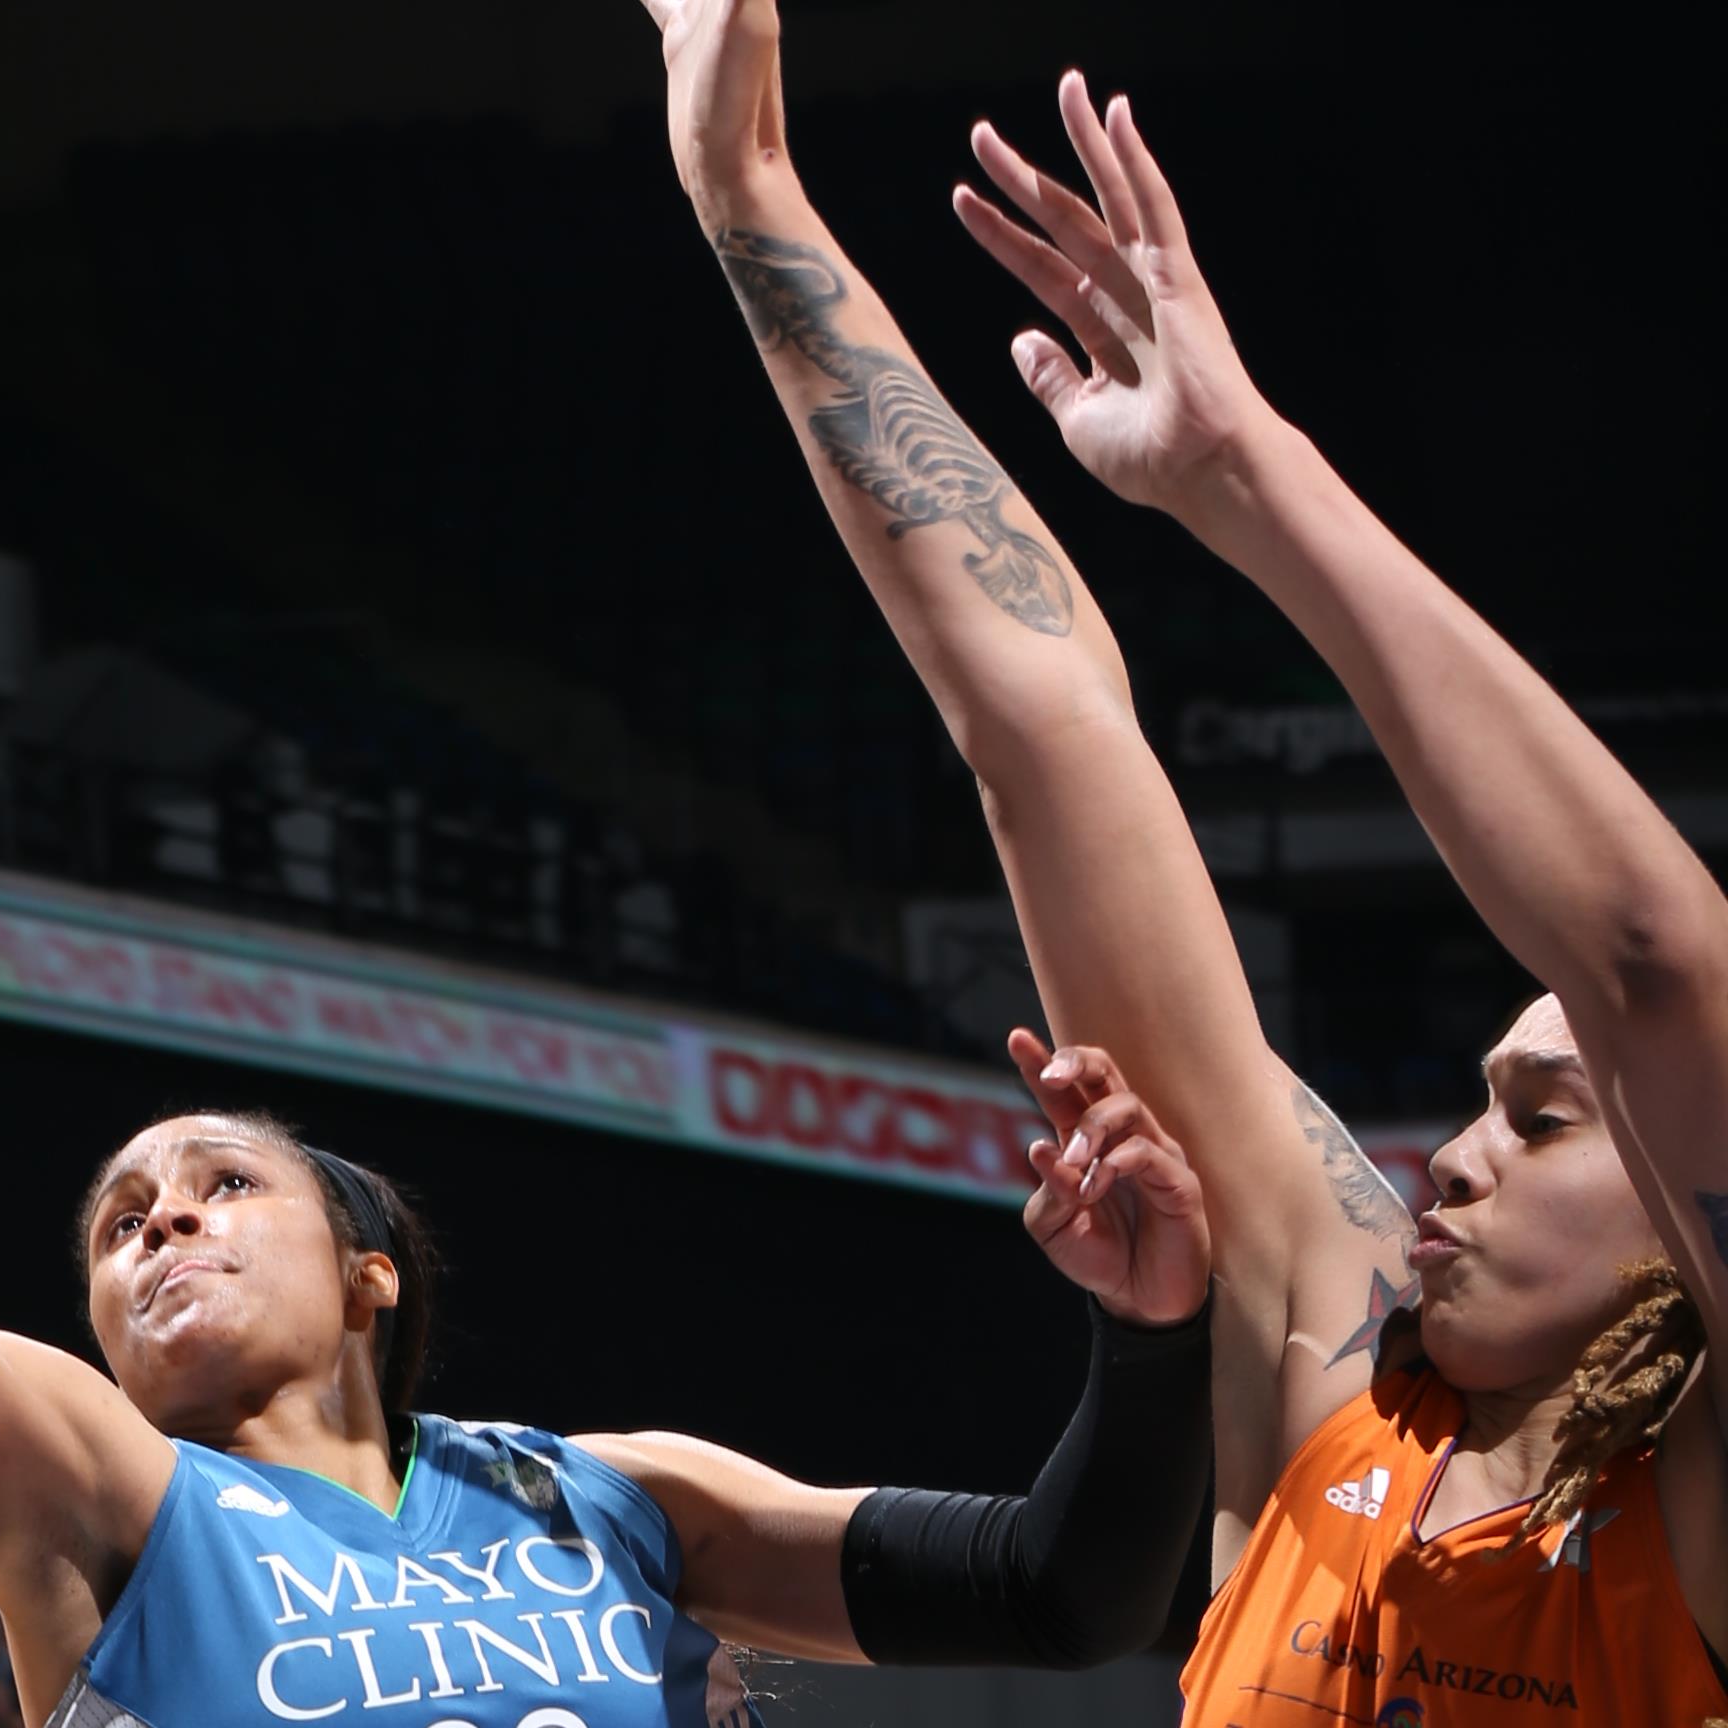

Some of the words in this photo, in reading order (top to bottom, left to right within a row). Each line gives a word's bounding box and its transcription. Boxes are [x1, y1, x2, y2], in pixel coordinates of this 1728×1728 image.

[257, 1536, 605, 1626] MAYO
[256, 1603, 663, 1722] CLINIC
[1395, 1645, 1579, 1711] ARIZONA
